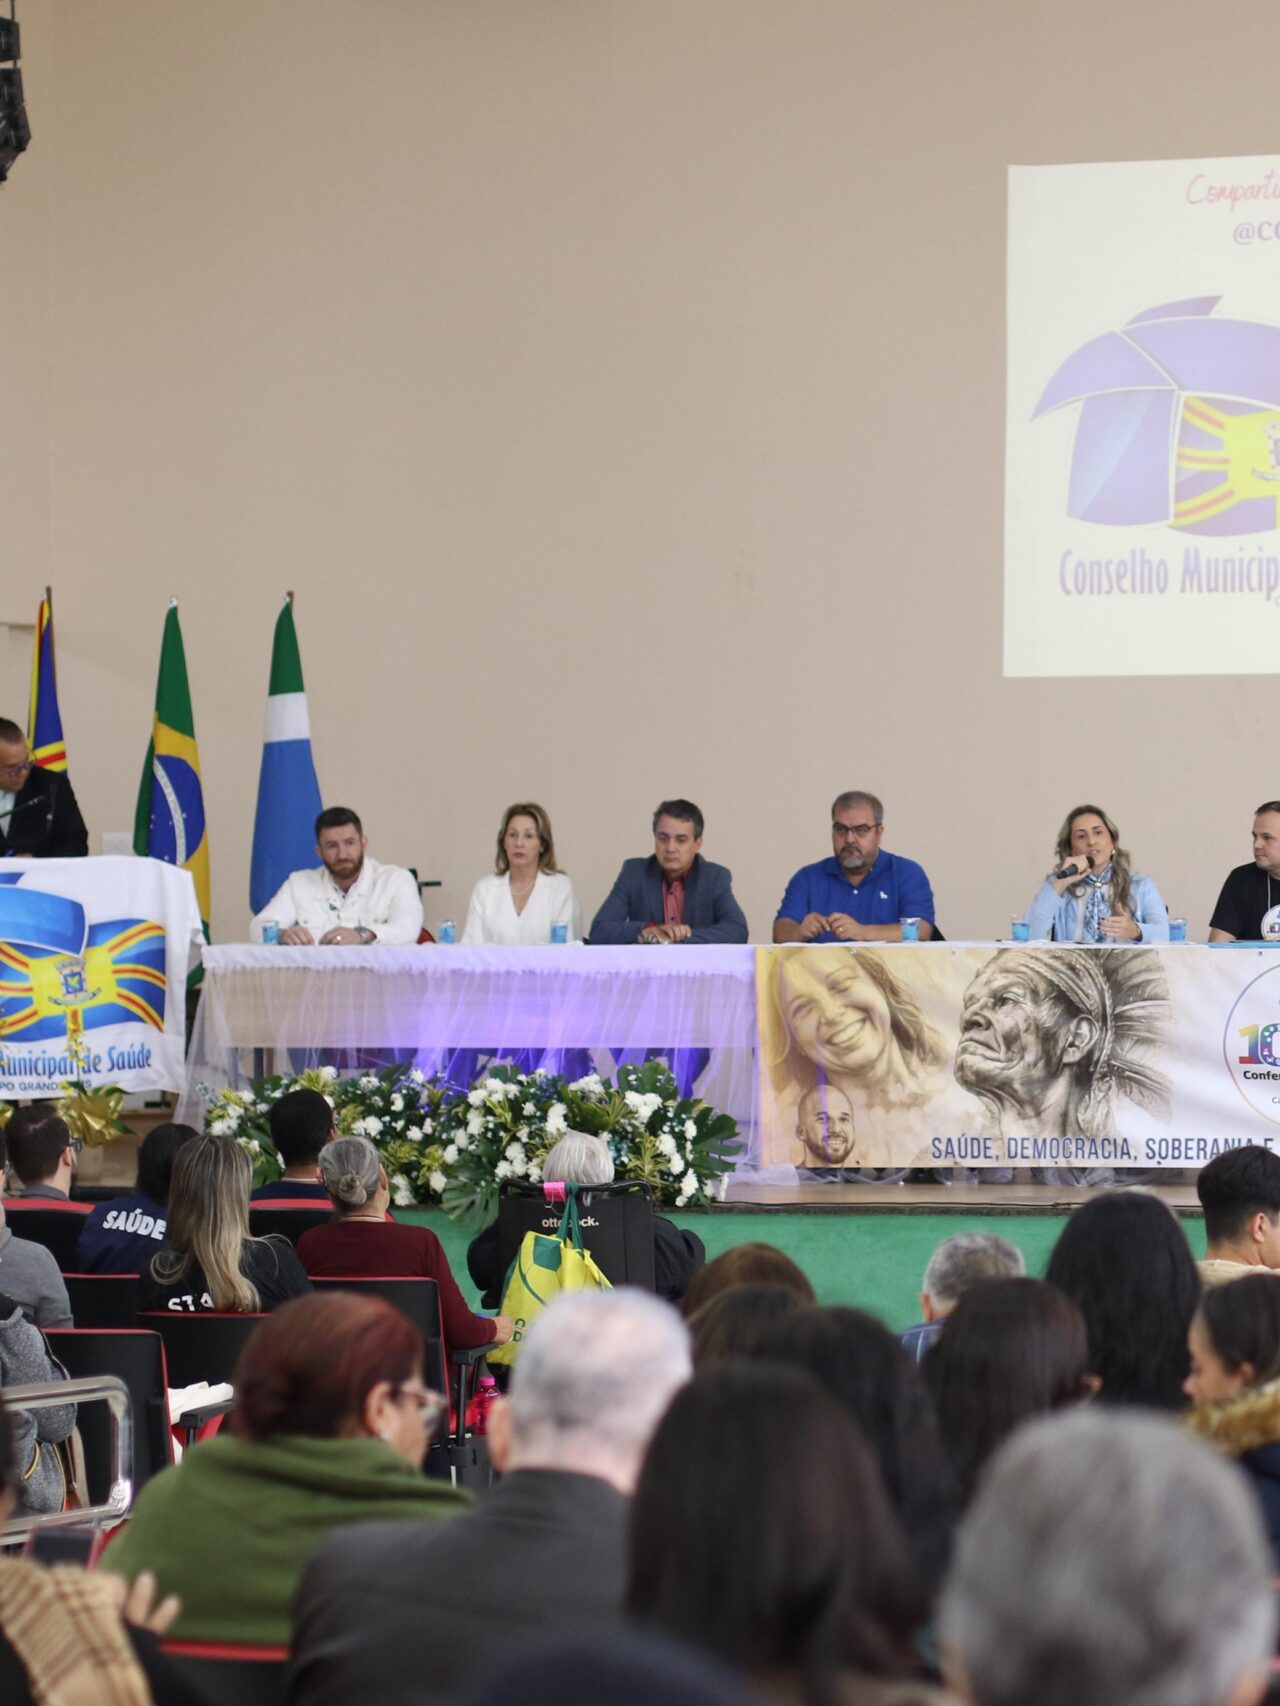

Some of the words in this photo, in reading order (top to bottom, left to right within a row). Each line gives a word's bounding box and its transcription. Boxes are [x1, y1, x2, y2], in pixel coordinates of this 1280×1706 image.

[1059, 548, 1169, 596] Conselho
[107, 1042, 152, 1073] Saúde
[931, 1133, 1000, 1161] SAÚDE,
[1007, 1137, 1138, 1162] DEMOCRACIA,
[102, 1208, 167, 1241] SAÚDE
